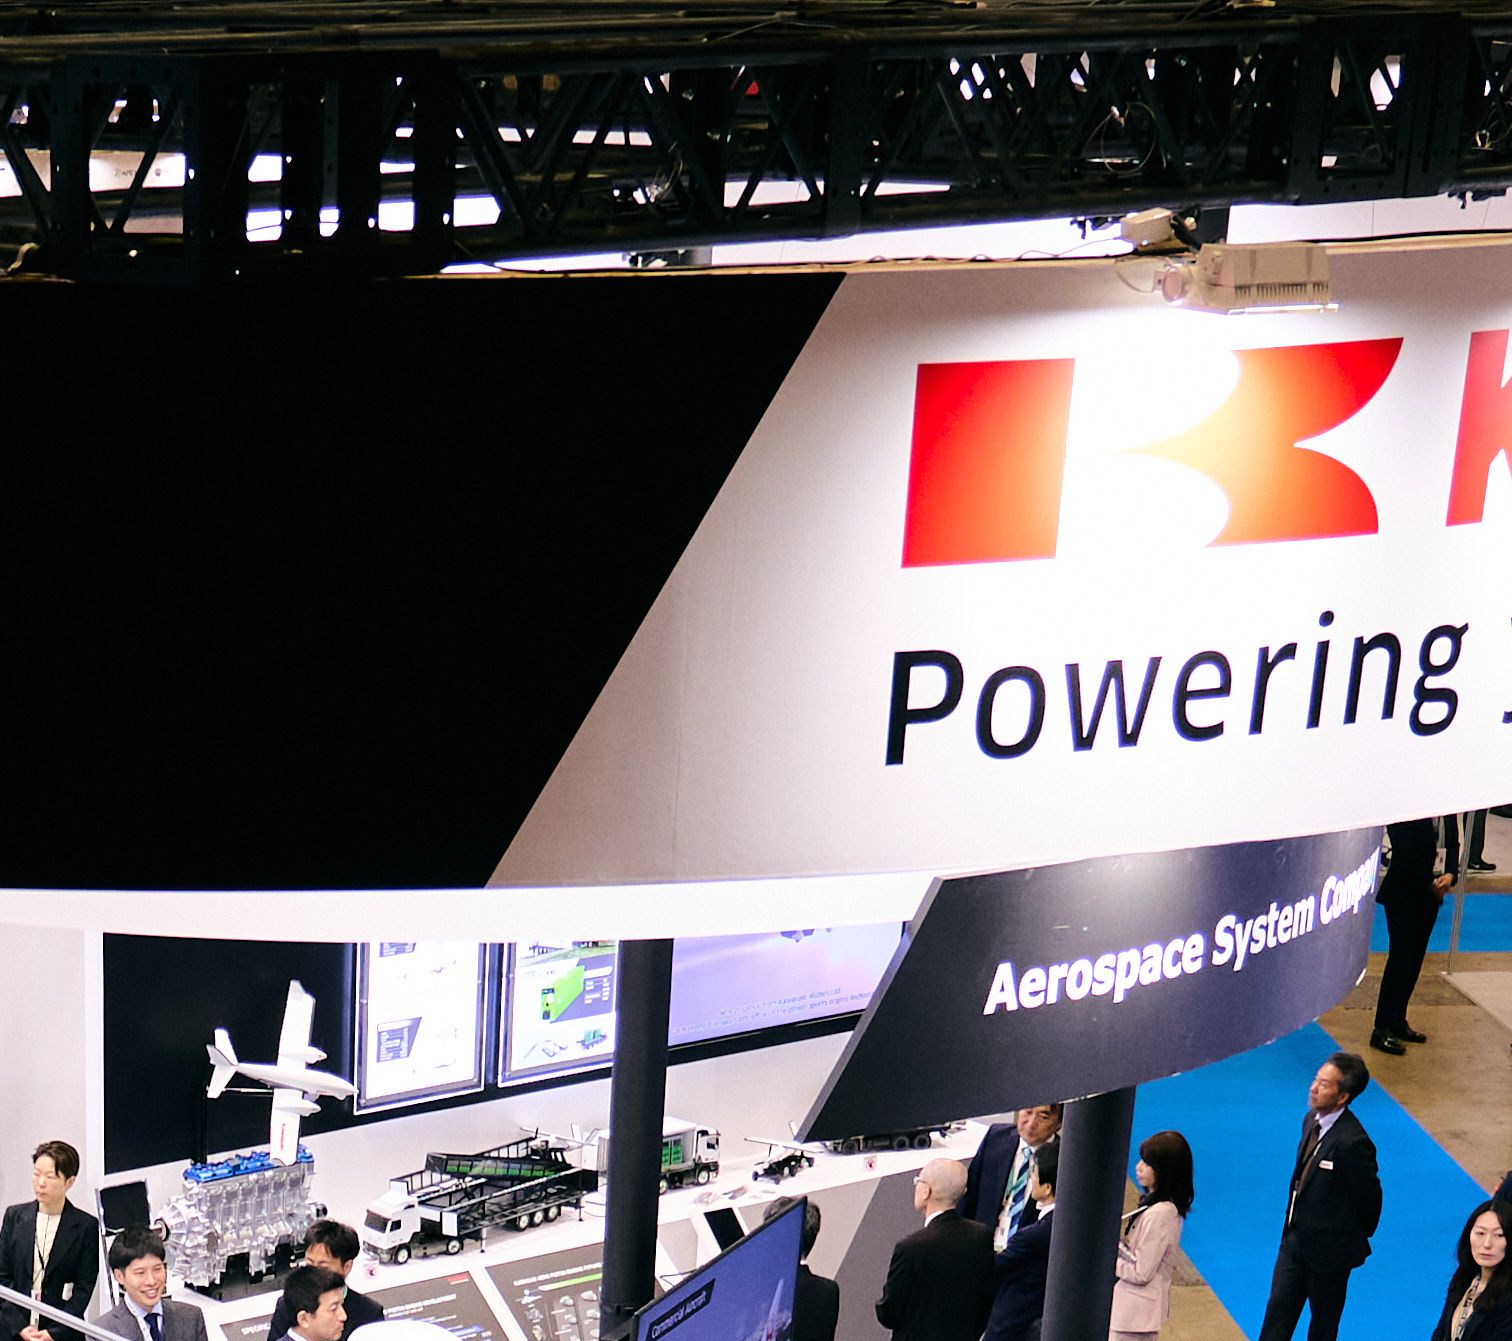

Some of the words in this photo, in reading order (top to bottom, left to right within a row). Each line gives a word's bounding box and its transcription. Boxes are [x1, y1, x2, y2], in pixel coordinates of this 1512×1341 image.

[884, 609, 1469, 766] Powering
[982, 952, 1205, 1017] Aerospace
[1211, 895, 1318, 972] System
[1318, 845, 1381, 927] Company
[651, 1302, 685, 1340] Commercial
